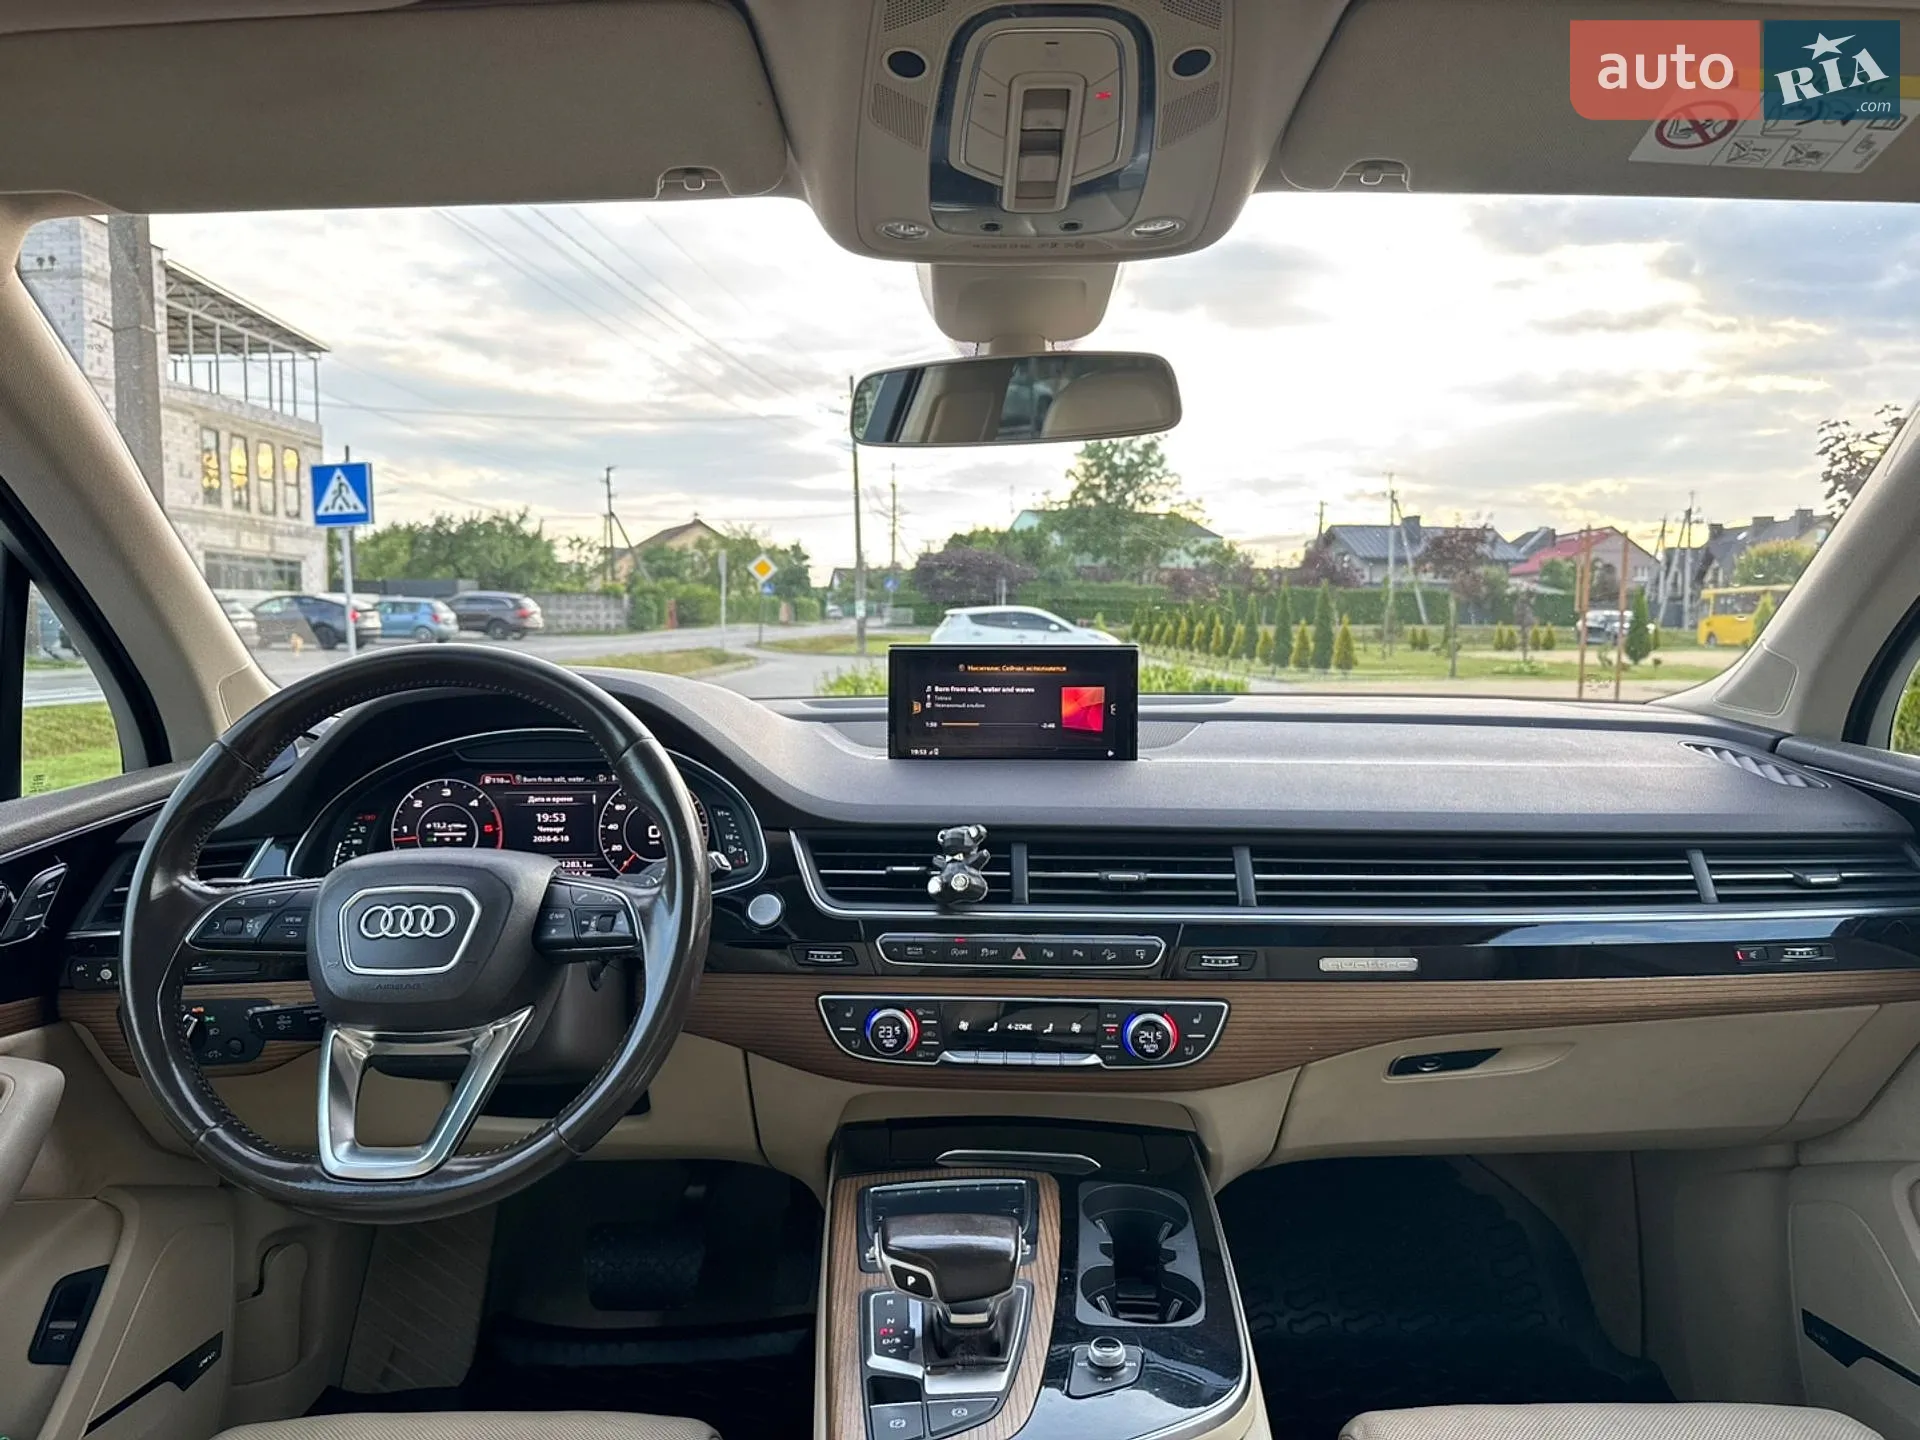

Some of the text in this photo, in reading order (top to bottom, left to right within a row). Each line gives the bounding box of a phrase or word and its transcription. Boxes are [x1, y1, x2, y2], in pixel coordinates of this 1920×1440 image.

[910, 748, 927, 756] 19:53
[441, 788, 452, 797] 3
[413, 799, 423, 808] 2
[468, 799, 479, 807] 4
[527, 795, 544, 803] Дата
[552, 796, 574, 804] время
[535, 812, 566, 823] 19:53
[402, 825, 408, 833] 1
[536, 825, 565, 834] Четверг
[1328, 960, 1410, 970] quattro
[1007, 1023, 1032, 1031] 4-ZONE
[907, 1275, 916, 1286] P
